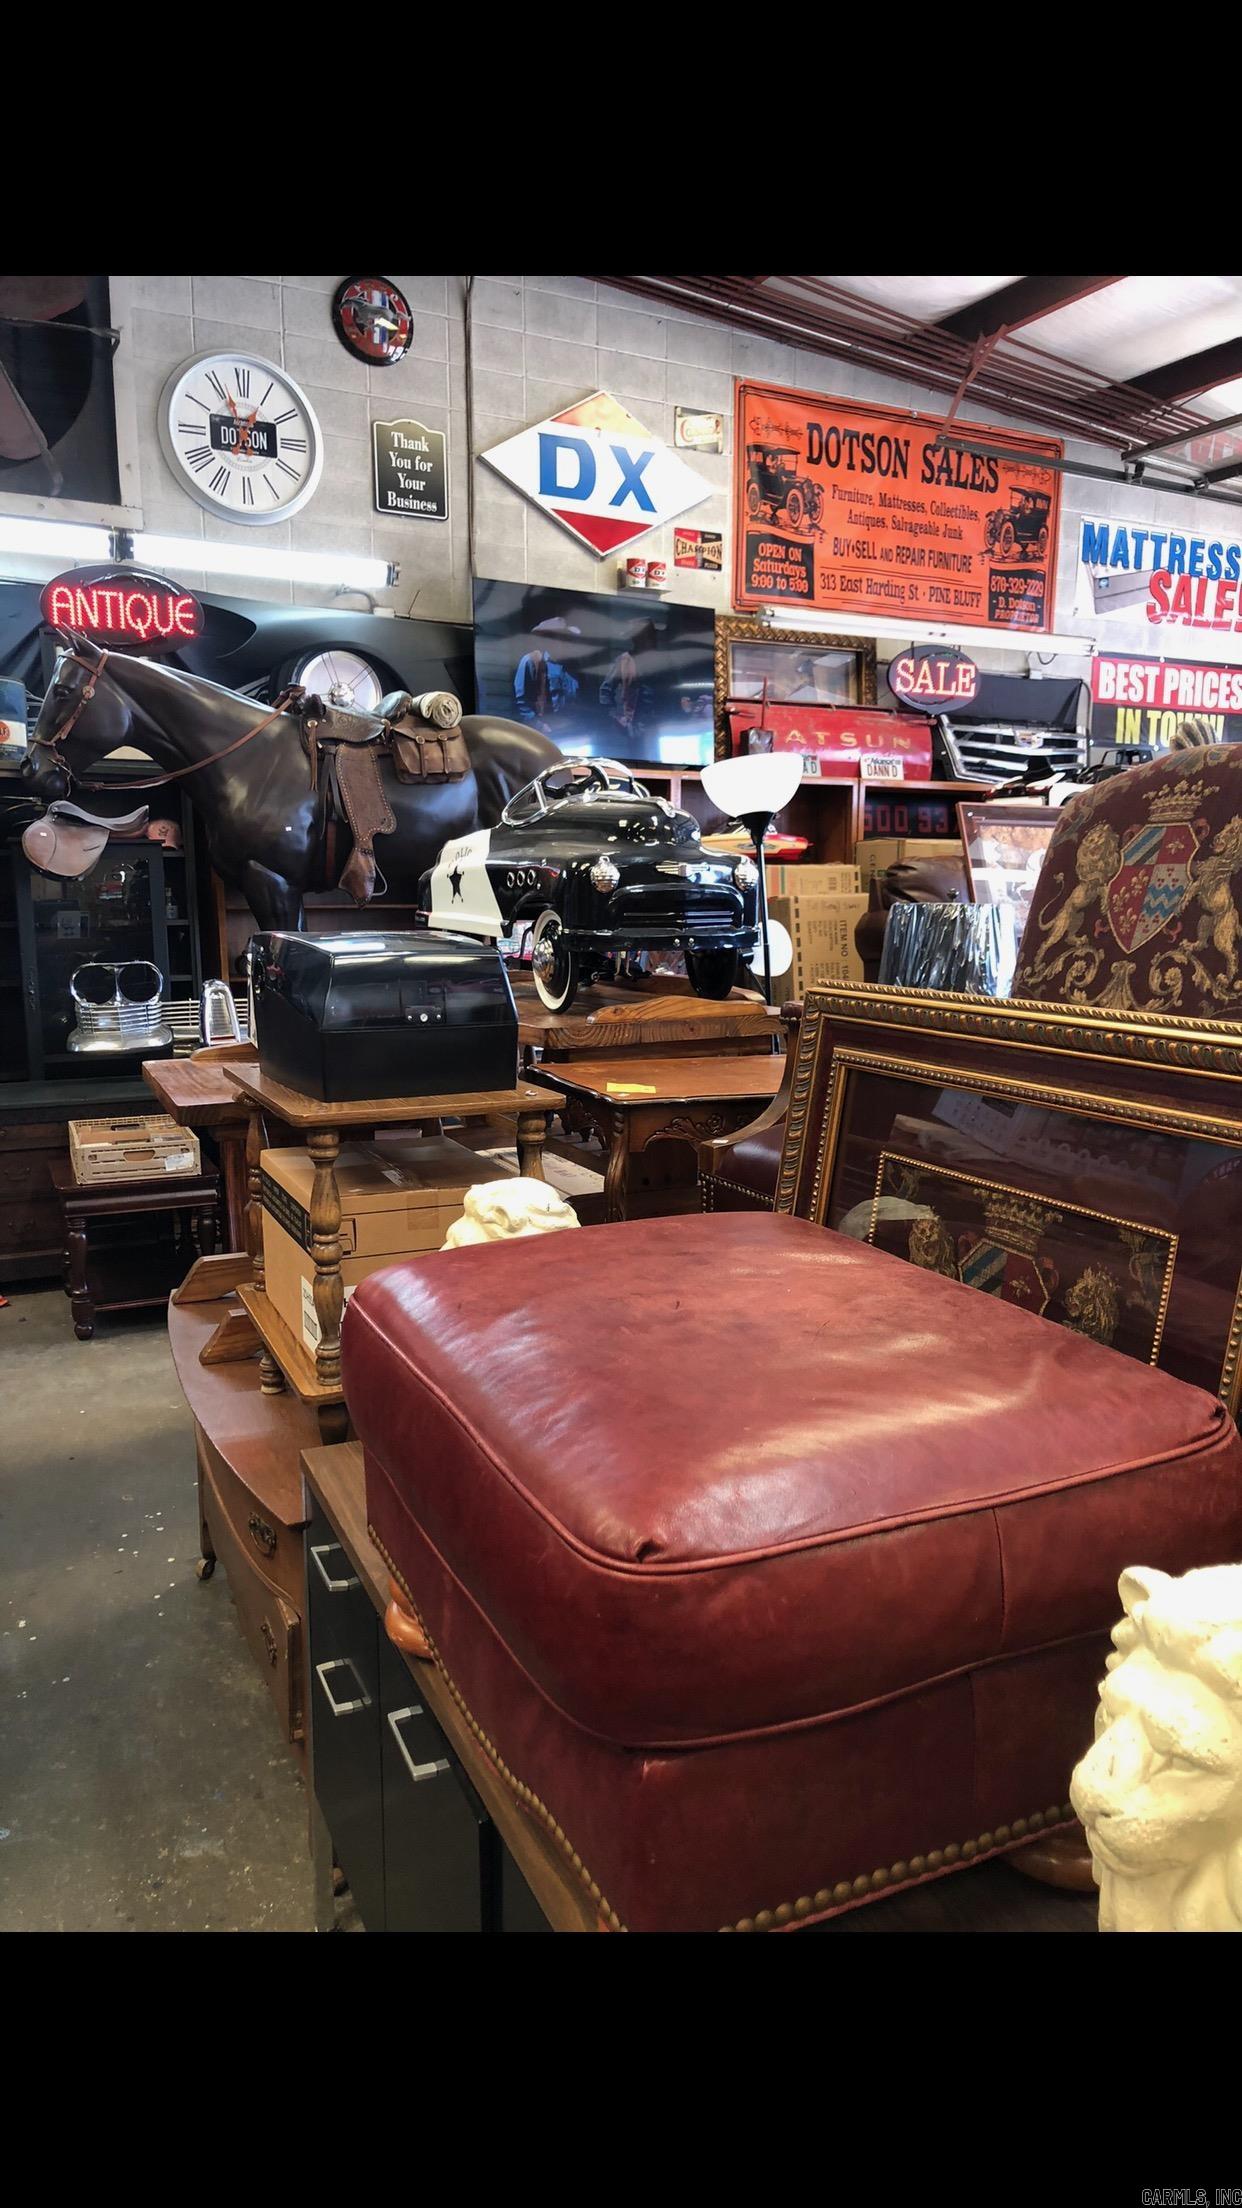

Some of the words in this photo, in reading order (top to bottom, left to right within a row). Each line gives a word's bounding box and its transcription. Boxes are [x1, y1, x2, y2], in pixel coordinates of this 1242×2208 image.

[391, 431, 430, 453] Thank
[388, 451, 412, 470] You
[414, 455, 433, 473] for
[806, 422, 910, 480] DOTSON
[921, 443, 999, 494] SALES
[396, 473, 426, 492] Your
[538, 432, 657, 513] DX
[387, 491, 438, 513] Business
[831, 484, 876, 506] Furniture,
[878, 492, 927, 514] Mattresses,
[930, 500, 981, 524] Collectibles,
[891, 515, 940, 538] Salvageable
[942, 523, 963, 540] Junk
[758, 543, 786, 559] OPEN
[788, 547, 802, 561] ON
[880, 549, 894, 562] AND
[896, 545, 926, 567] REPAIR
[928, 550, 973, 574] FURNITURE
[1081, 521, 1241, 581] MATTRESS
[753, 558, 806, 579] Saturdays
[776, 576, 787, 590] to
[820, 573, 836, 591] 313
[840, 575, 863, 594] East
[866, 578, 906, 604] Harding
[908, 584, 919, 600] St
[929, 586, 951, 604] PINE
[954, 589, 982, 608] BLUFF
[52, 587, 196, 639] ANTIQUE
[896, 658, 977, 697] SALE
[1098, 661, 1160, 704] BEST
[1162, 664, 1242, 710] PRICES
[785, 729, 911, 749] ATSUN
[1115, 707, 1142, 745] IN
[1147, 710, 1225, 748] TO!
[840, 920, 848, 941] ITEM
[841, 943, 849, 957] NO
